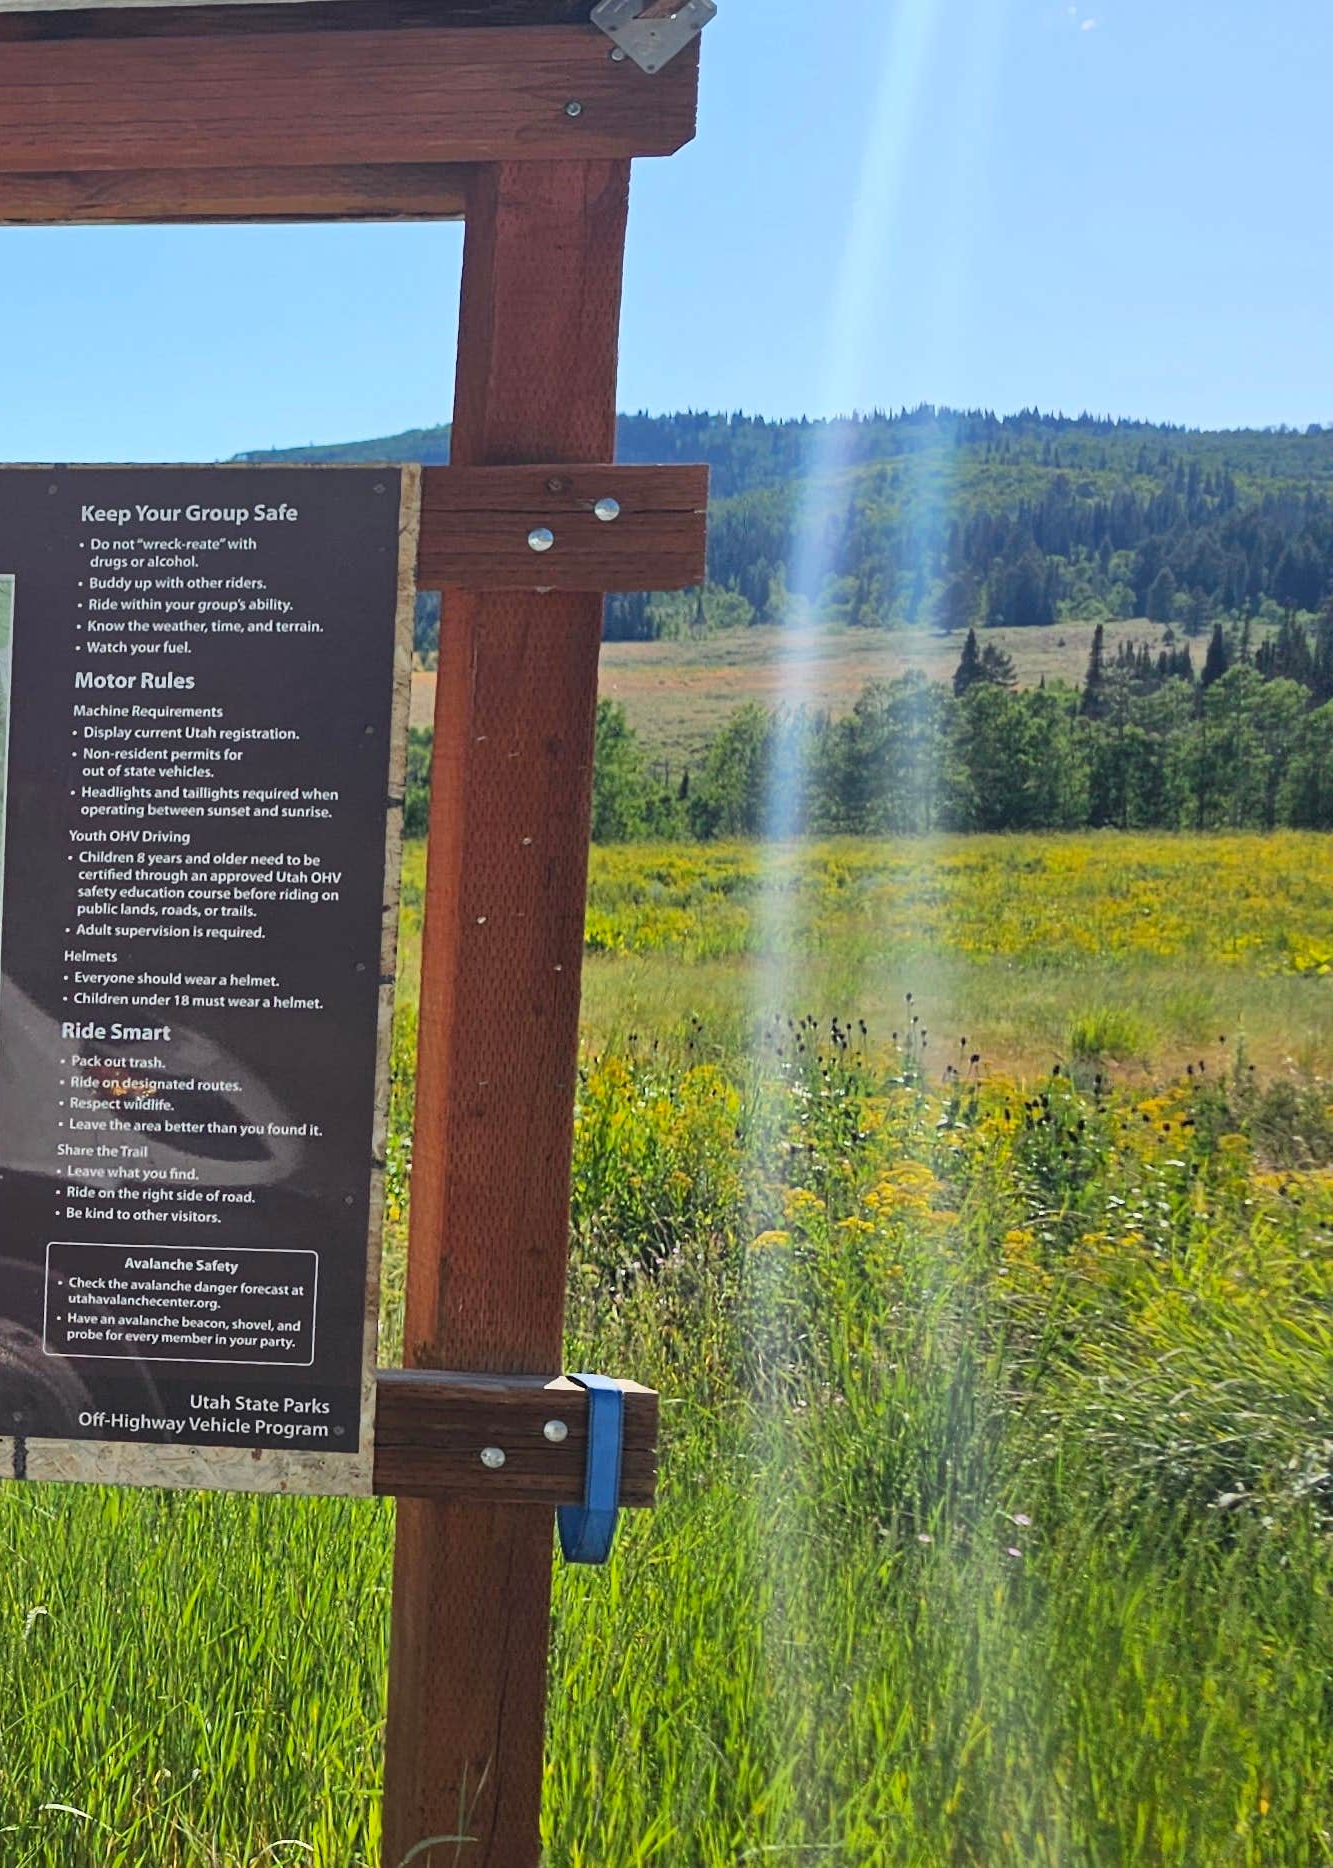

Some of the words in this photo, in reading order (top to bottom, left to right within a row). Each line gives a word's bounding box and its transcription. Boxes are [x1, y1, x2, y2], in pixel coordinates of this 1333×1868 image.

[81, 505, 131, 526] Keep
[135, 505, 182, 522] Your
[185, 504, 249, 525] Group
[253, 504, 298, 522] Safe
[90, 538, 109, 551] Do
[113, 538, 134, 551] not
[137, 538, 226, 550] “wreck-reate”
[228, 538, 257, 551] with
[90, 556, 128, 570] drugs
[130, 558, 144, 568] or
[147, 555, 199, 568] alcohol.
[89, 577, 132, 592] Buddy
[134, 579, 152, 592] up
[155, 577, 184, 590] with
[187, 577, 223, 590] other
[225, 577, 267, 590] riders.
[87, 641, 128, 654] Watch
[130, 644, 160, 657] your
[163, 641, 192, 654] fuel.
[74, 672, 136, 689] Motor
[141, 672, 196, 690] Rules
[73, 705, 129, 718] Machine
[131, 705, 223, 720] Requirements
[84, 726, 132, 742] Display
[134, 727, 183, 740] current
[185, 726, 217, 740] Utah
[219, 727, 300, 742] registration.
[83, 748, 168, 761] Non-resident
[171, 749, 221, 763] permits
[223, 748, 243, 761] for
[82, 766, 104, 778] out
[107, 765, 121, 777] of
[123, 765, 156, 778] state
[159, 765, 214, 779] vehicles.
[69, 830, 107, 843] Youth
[109, 830, 140, 843] OHV
[142, 830, 190, 846] Driving
[76, 925, 112, 938] Adult
[115, 925, 190, 940] supervision
[193, 925, 203, 938] is
[205, 926, 266, 940] required.
[64, 950, 118, 964] Helmets
[74, 972, 135, 987] Everyone
[137, 973, 182, 985] should
[184, 975, 216, 986] wear
[218, 977, 227, 986] a
[229, 974, 280, 987] helmet.
[61, 1022, 106, 1040] Ride
[110, 1023, 171, 1042] Smart
[71, 1055, 102, 1068] Pack
[104, 1057, 127, 1068] out
[129, 1056, 166, 1069] trash.
[57, 1144, 94, 1157] Share
[97, 1145, 118, 1157] the
[120, 1145, 148, 1158] Trail
[68, 1166, 104, 1179] Leave
[107, 1166, 140, 1179] what
[142, 1170, 167, 1182] you
[169, 1167, 199, 1180] find.
[66, 1207, 82, 1220] Be
[85, 1208, 114, 1221] kind
[117, 1210, 130, 1221] to
[133, 1209, 168, 1222] other
[171, 1210, 222, 1223] visitors.
[124, 1257, 194, 1272] Avalanche
[196, 1259, 238, 1275] Safety
[68, 1293, 221, 1311] utahavalanchecenter.org.
[190, 1394, 231, 1410] Utah
[235, 1396, 279, 1412] State
[283, 1397, 330, 1414] Parks
[78, 1412, 185, 1434] Off-Highway
[188, 1417, 251, 1434] Vehicle
[255, 1420, 329, 1439] Program
